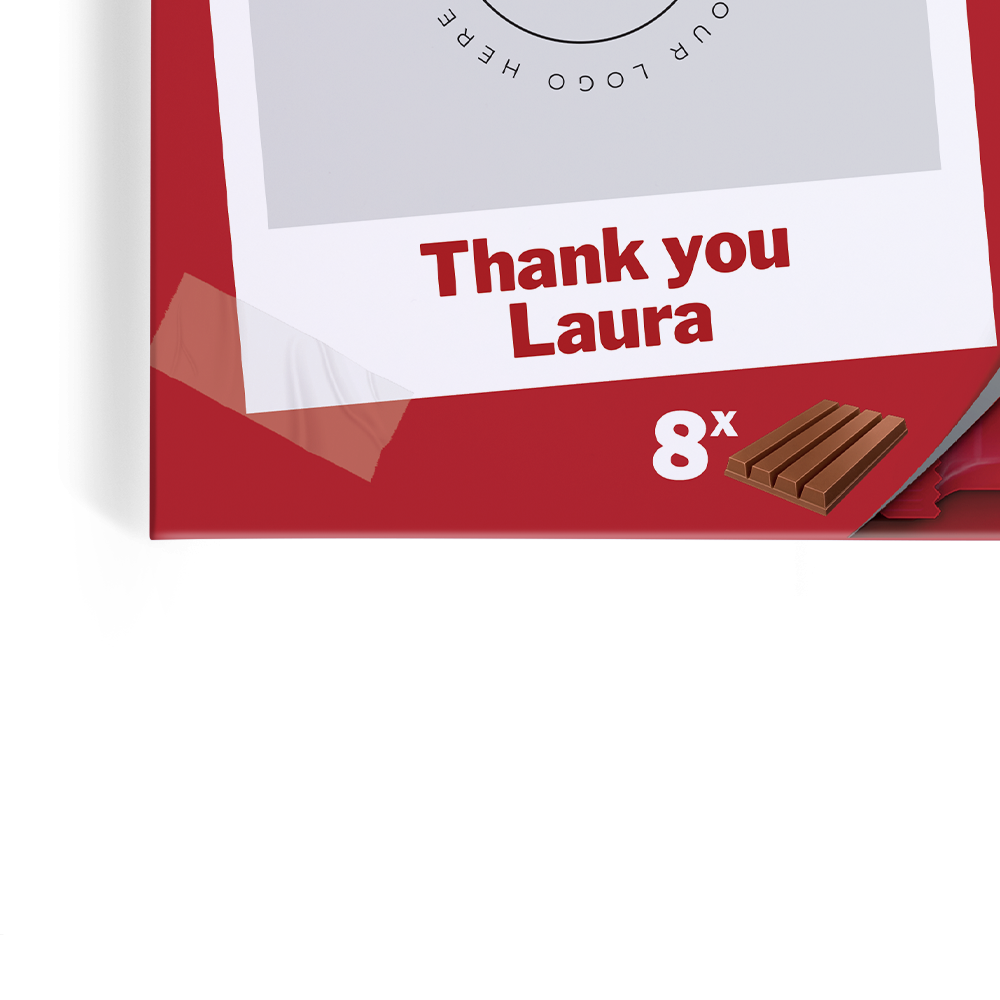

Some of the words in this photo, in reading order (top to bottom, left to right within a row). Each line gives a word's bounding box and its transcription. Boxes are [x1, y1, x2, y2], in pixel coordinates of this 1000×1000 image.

[438, 9, 520, 78] HERE
[548, 64, 648, 91] LOGO
[420, 227, 649, 297] Thank
[662, 228, 790, 289] you
[509, 303, 713, 358] Laura
